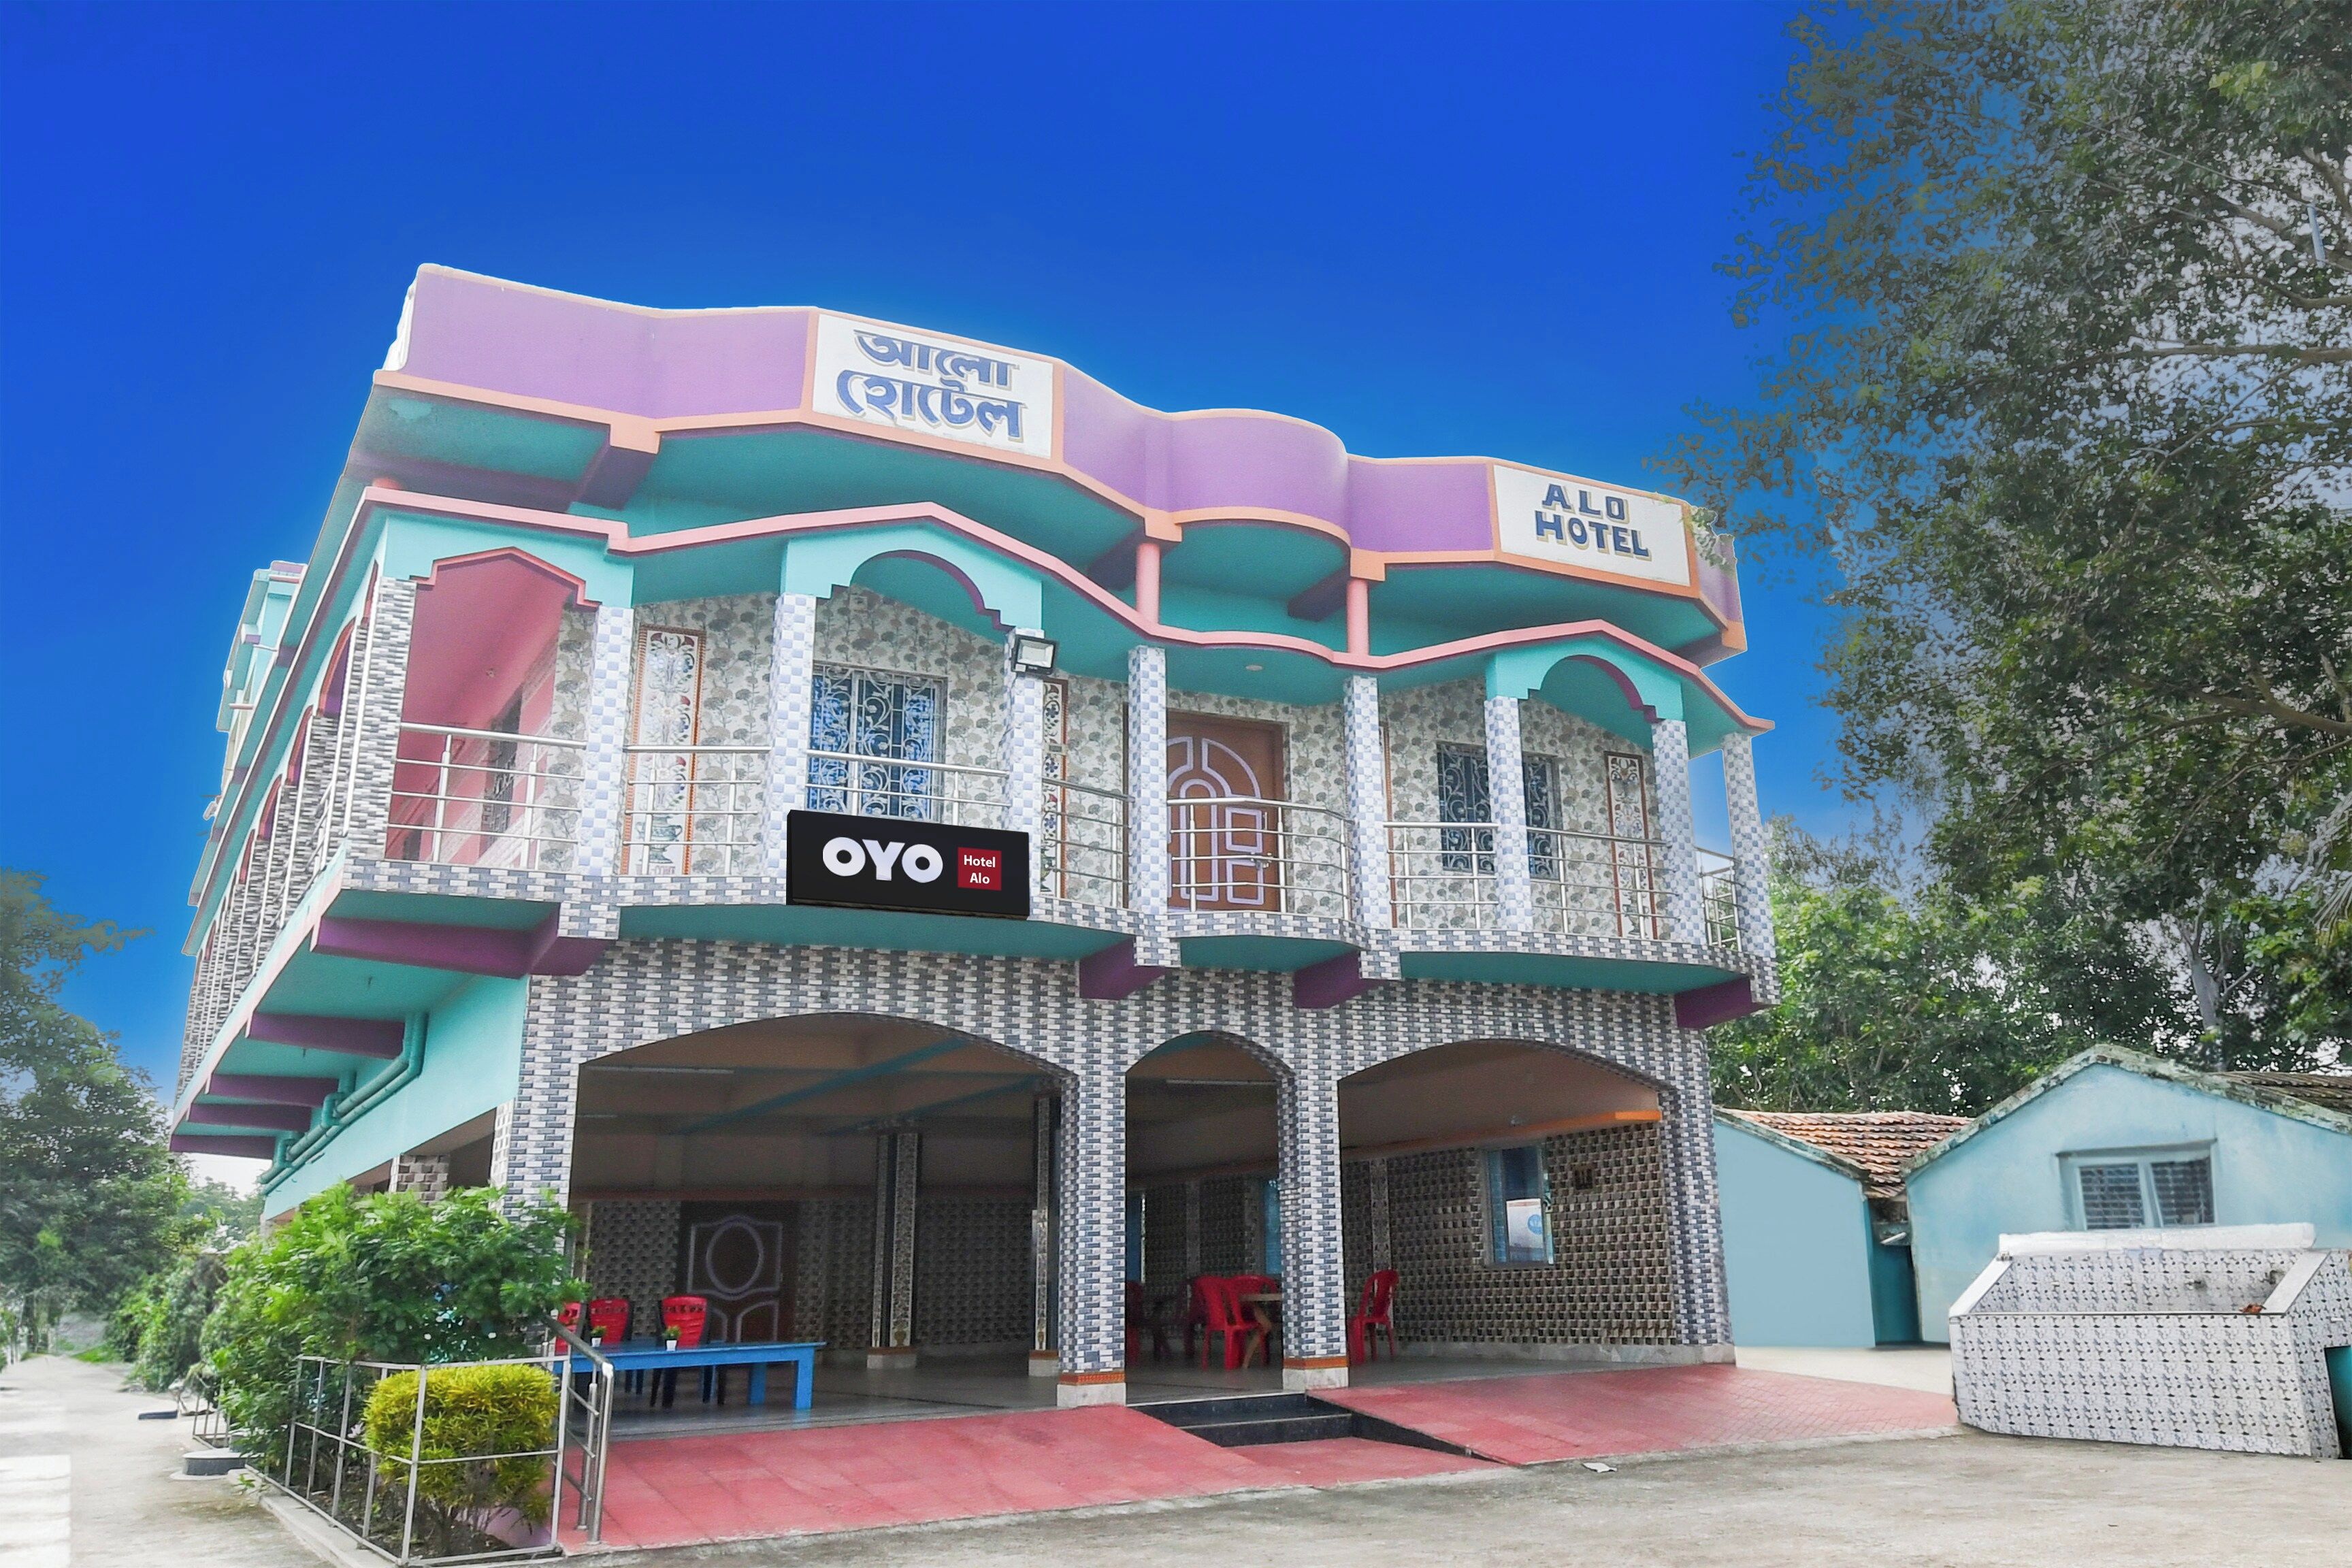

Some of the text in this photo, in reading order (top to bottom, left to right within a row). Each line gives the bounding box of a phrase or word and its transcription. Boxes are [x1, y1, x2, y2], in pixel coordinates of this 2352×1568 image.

[853, 329, 1017, 389] আলো
[836, 369, 1026, 441] হোটেল
[1542, 483, 1627, 522] ALO
[1535, 510, 1650, 559] HOTEL
[822, 836, 943, 883] OYO
[963, 854, 996, 868] Hotel
[969, 872, 990, 885] Alo
